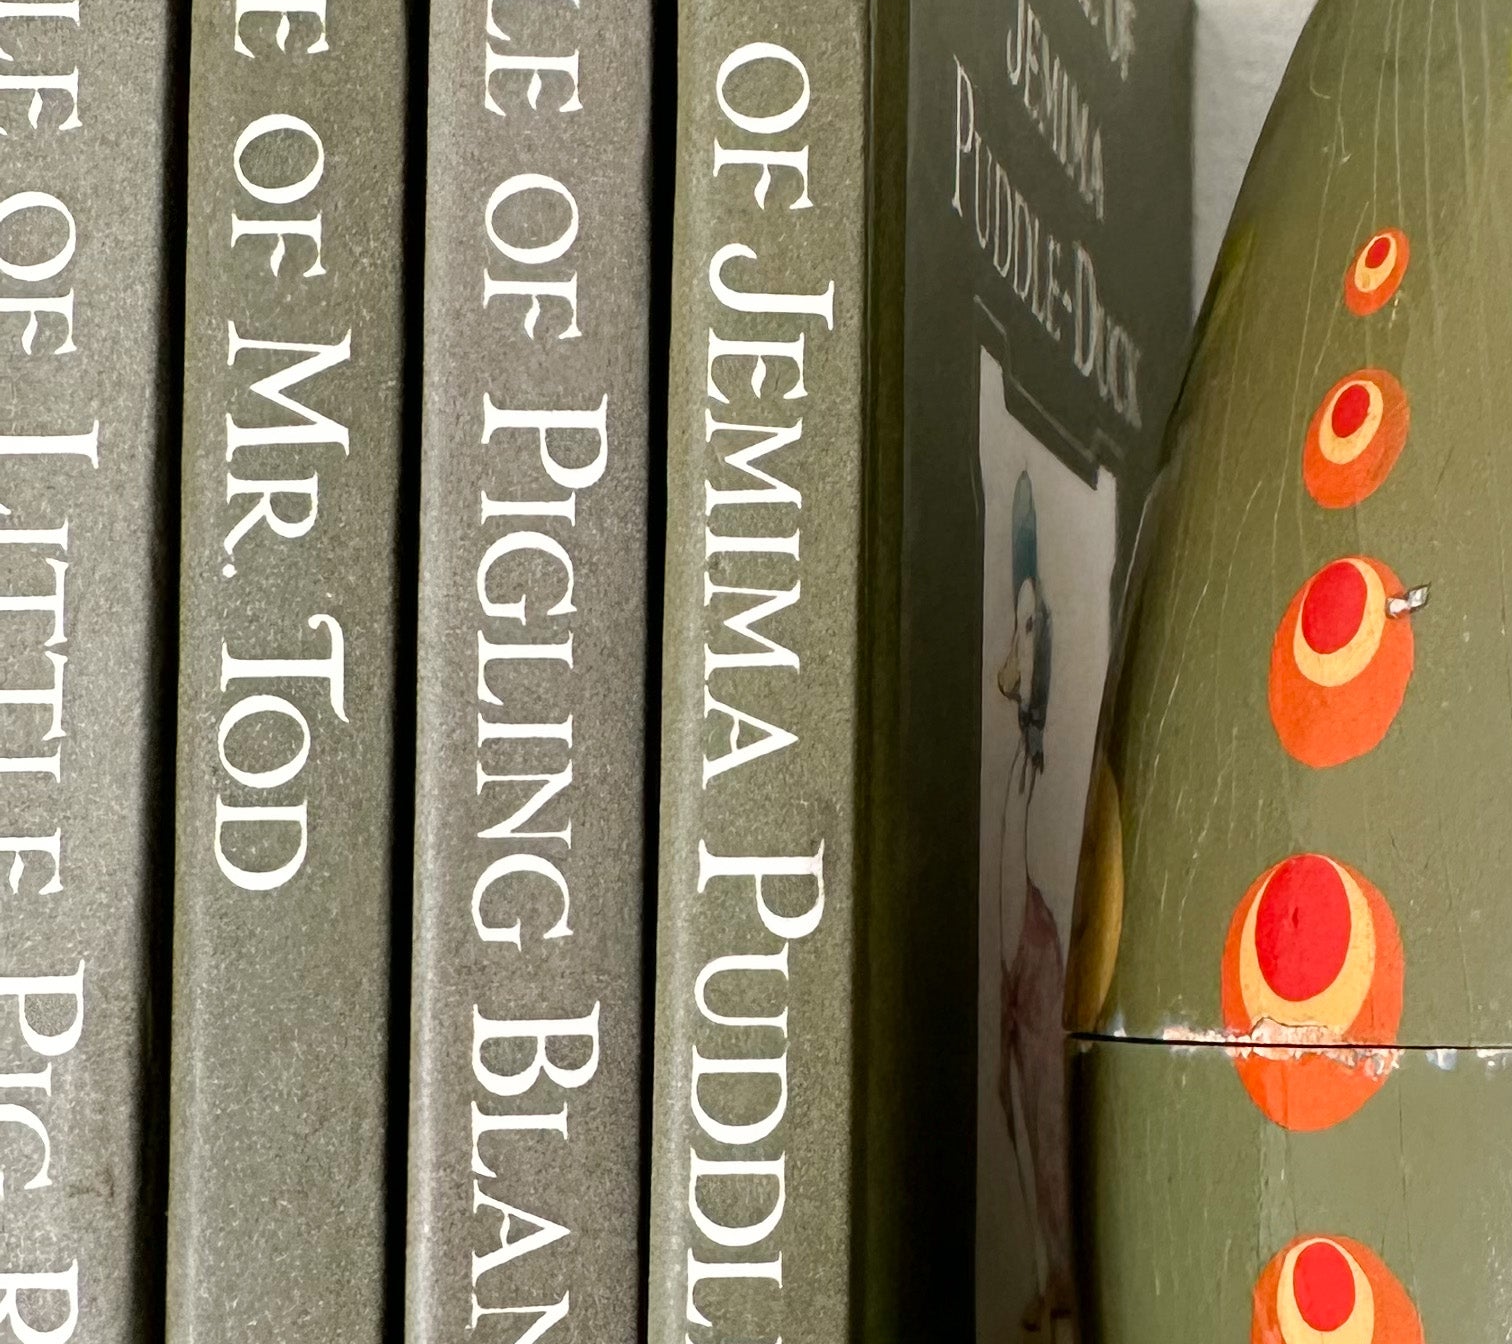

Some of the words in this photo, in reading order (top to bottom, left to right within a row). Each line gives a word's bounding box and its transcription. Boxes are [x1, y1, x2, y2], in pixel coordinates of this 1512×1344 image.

[231, 114, 326, 277] OF
[713, 42, 813, 210] OF
[0, 191, 77, 355] OF
[483, 173, 582, 340] OF
[220, 320, 351, 578] MR.
[702, 243, 834, 790] JEMIMA
[214, 614, 349, 890] TOD
[471, 392, 608, 951] PIGLING
